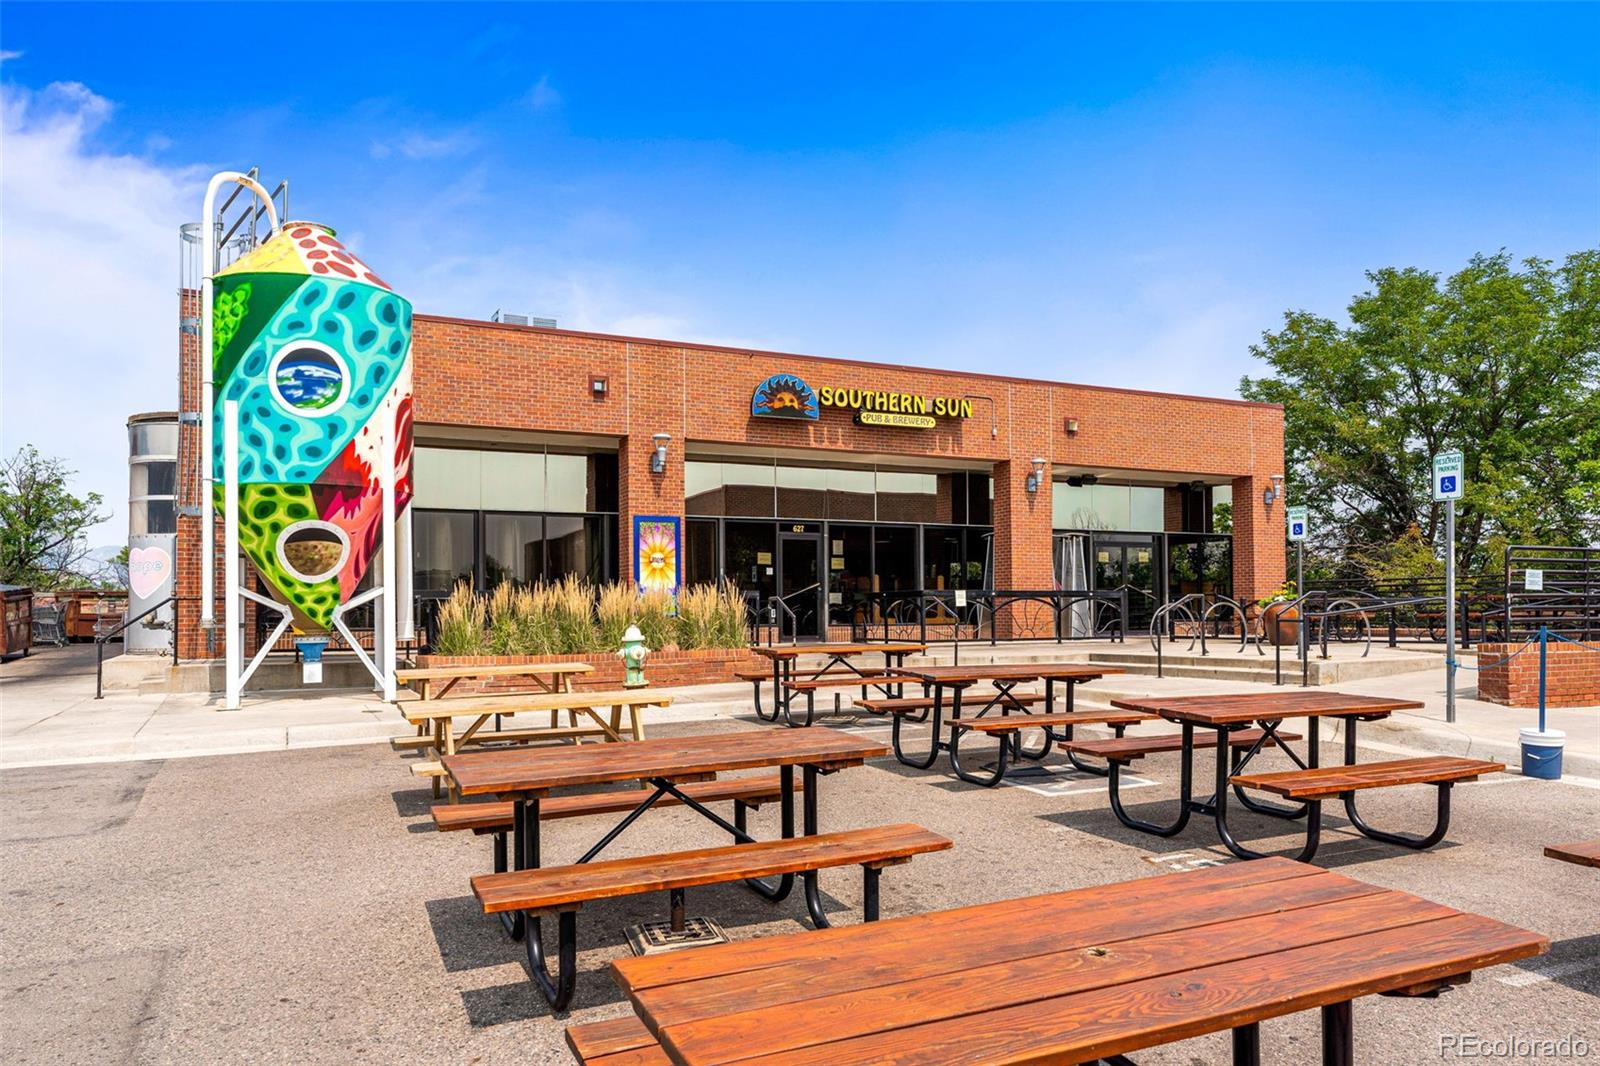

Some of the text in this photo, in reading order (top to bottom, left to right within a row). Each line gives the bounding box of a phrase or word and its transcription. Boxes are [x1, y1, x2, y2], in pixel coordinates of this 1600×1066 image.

[820, 386, 973, 418] SOUTHERN SUN
[866, 413, 931, 426] PUB & BREWERY
[1435, 456, 1462, 465] RESERVED
